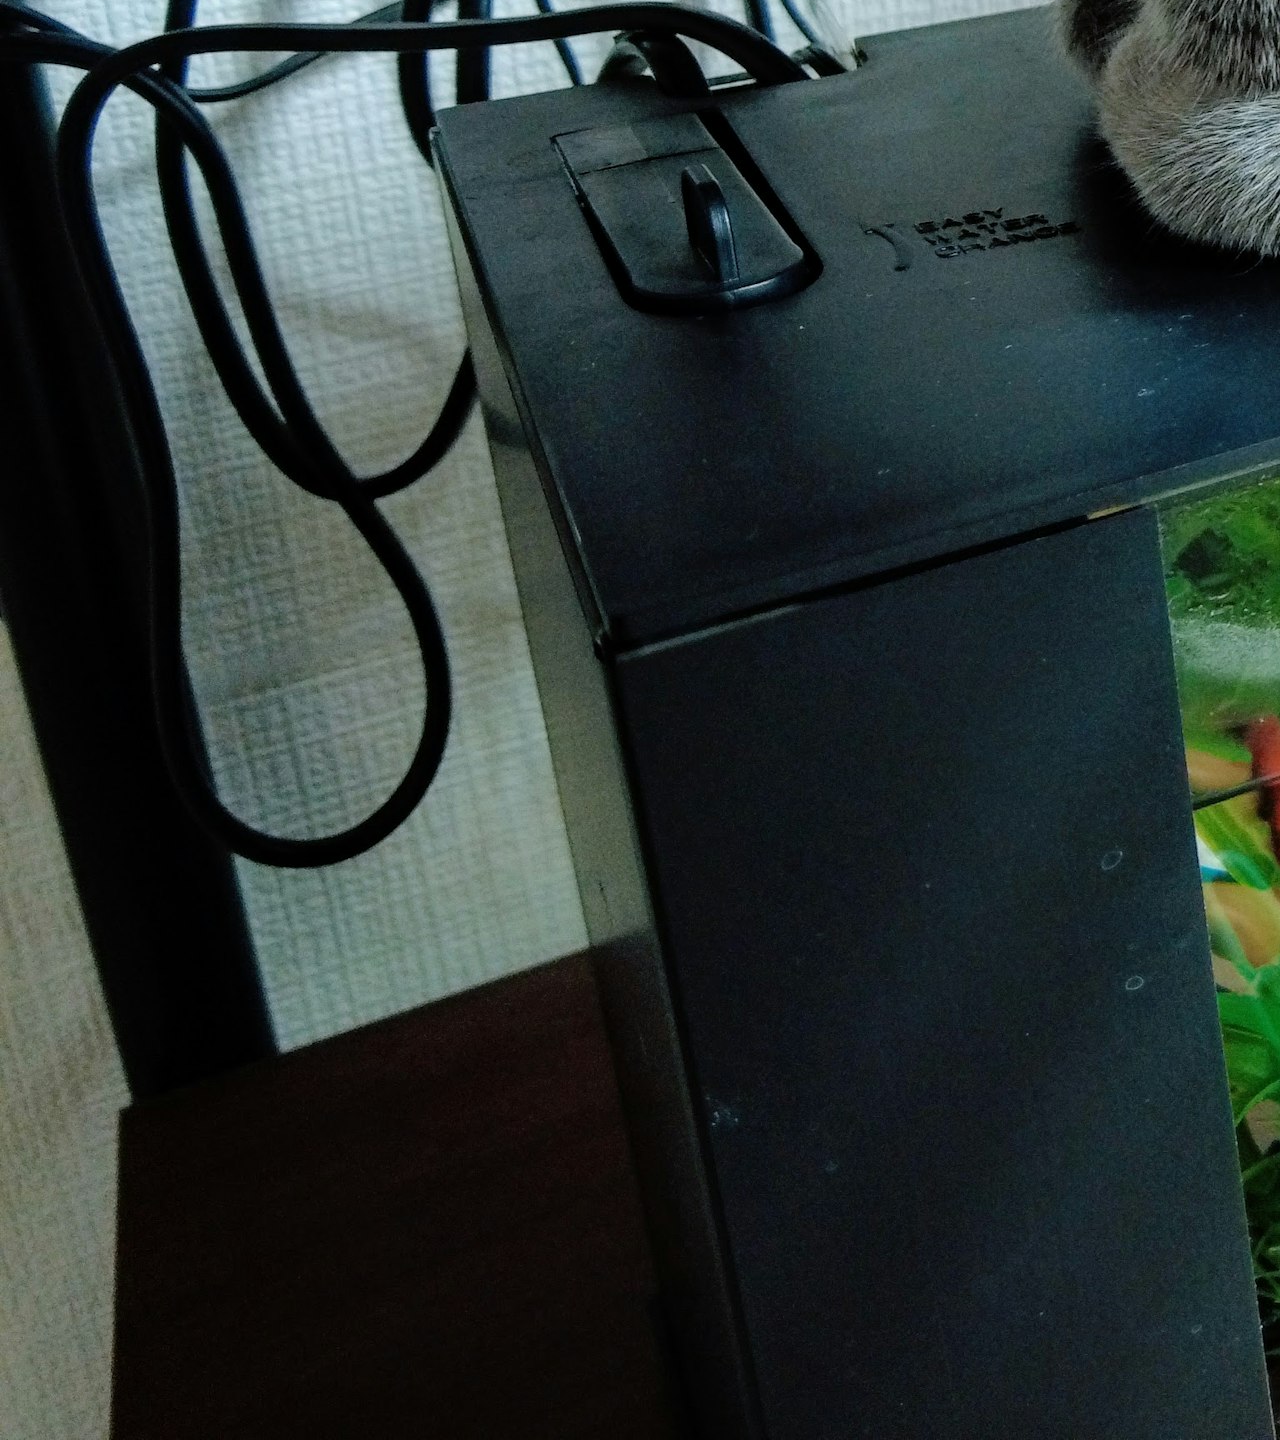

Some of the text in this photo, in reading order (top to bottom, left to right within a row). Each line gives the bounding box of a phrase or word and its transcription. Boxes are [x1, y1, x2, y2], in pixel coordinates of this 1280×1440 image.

[913, 207, 1003, 235] EASY
[924, 213, 1049, 246] WATER
[934, 220, 1082, 259] CHANGE
